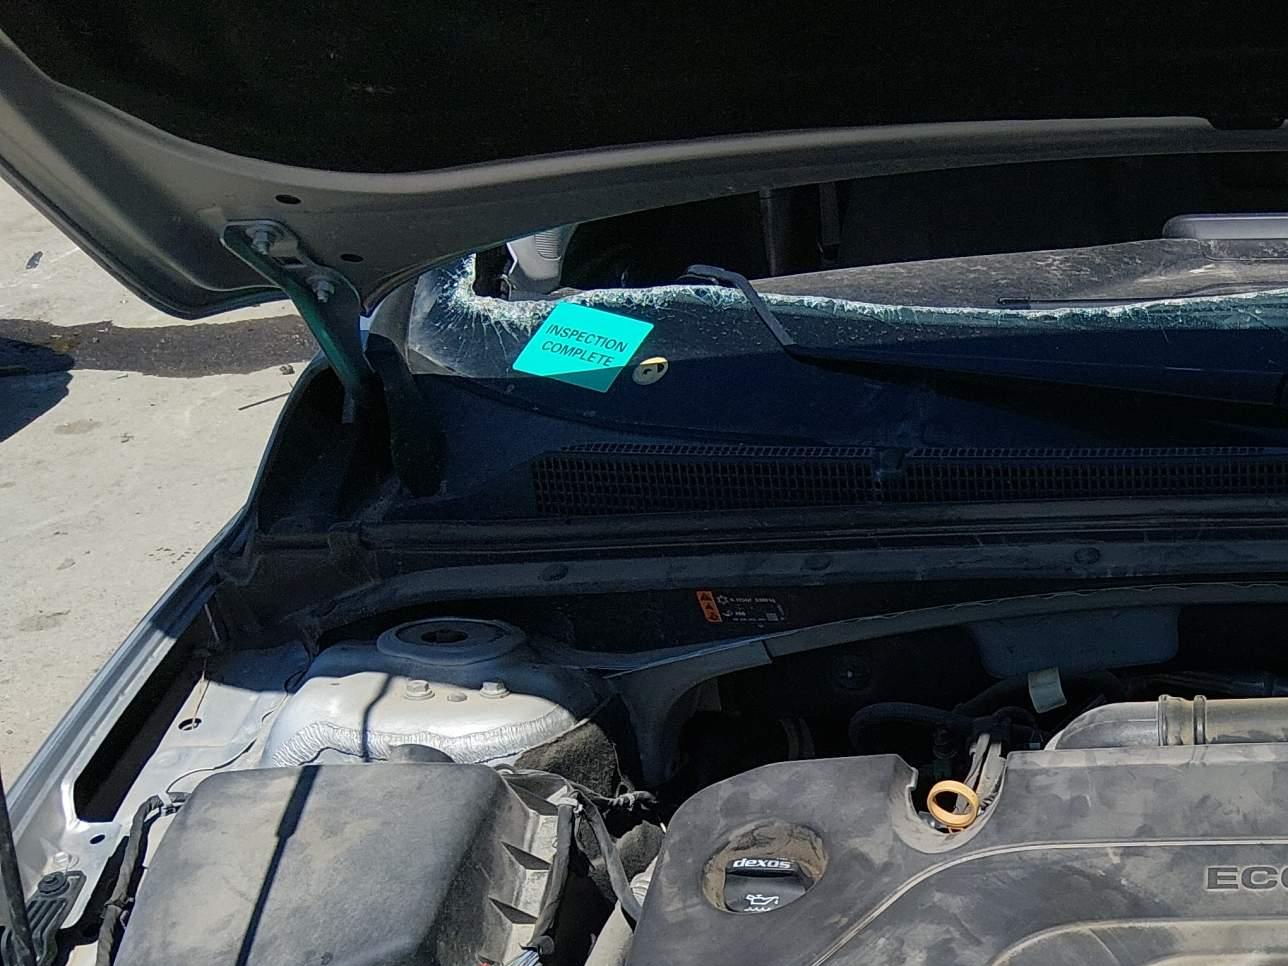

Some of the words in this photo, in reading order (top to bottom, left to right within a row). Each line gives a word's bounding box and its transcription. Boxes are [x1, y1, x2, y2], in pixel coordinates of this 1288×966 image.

[545, 324, 629, 352] INSPECTION
[541, 340, 615, 367] COMPLETE
[732, 857, 791, 869] dexos
